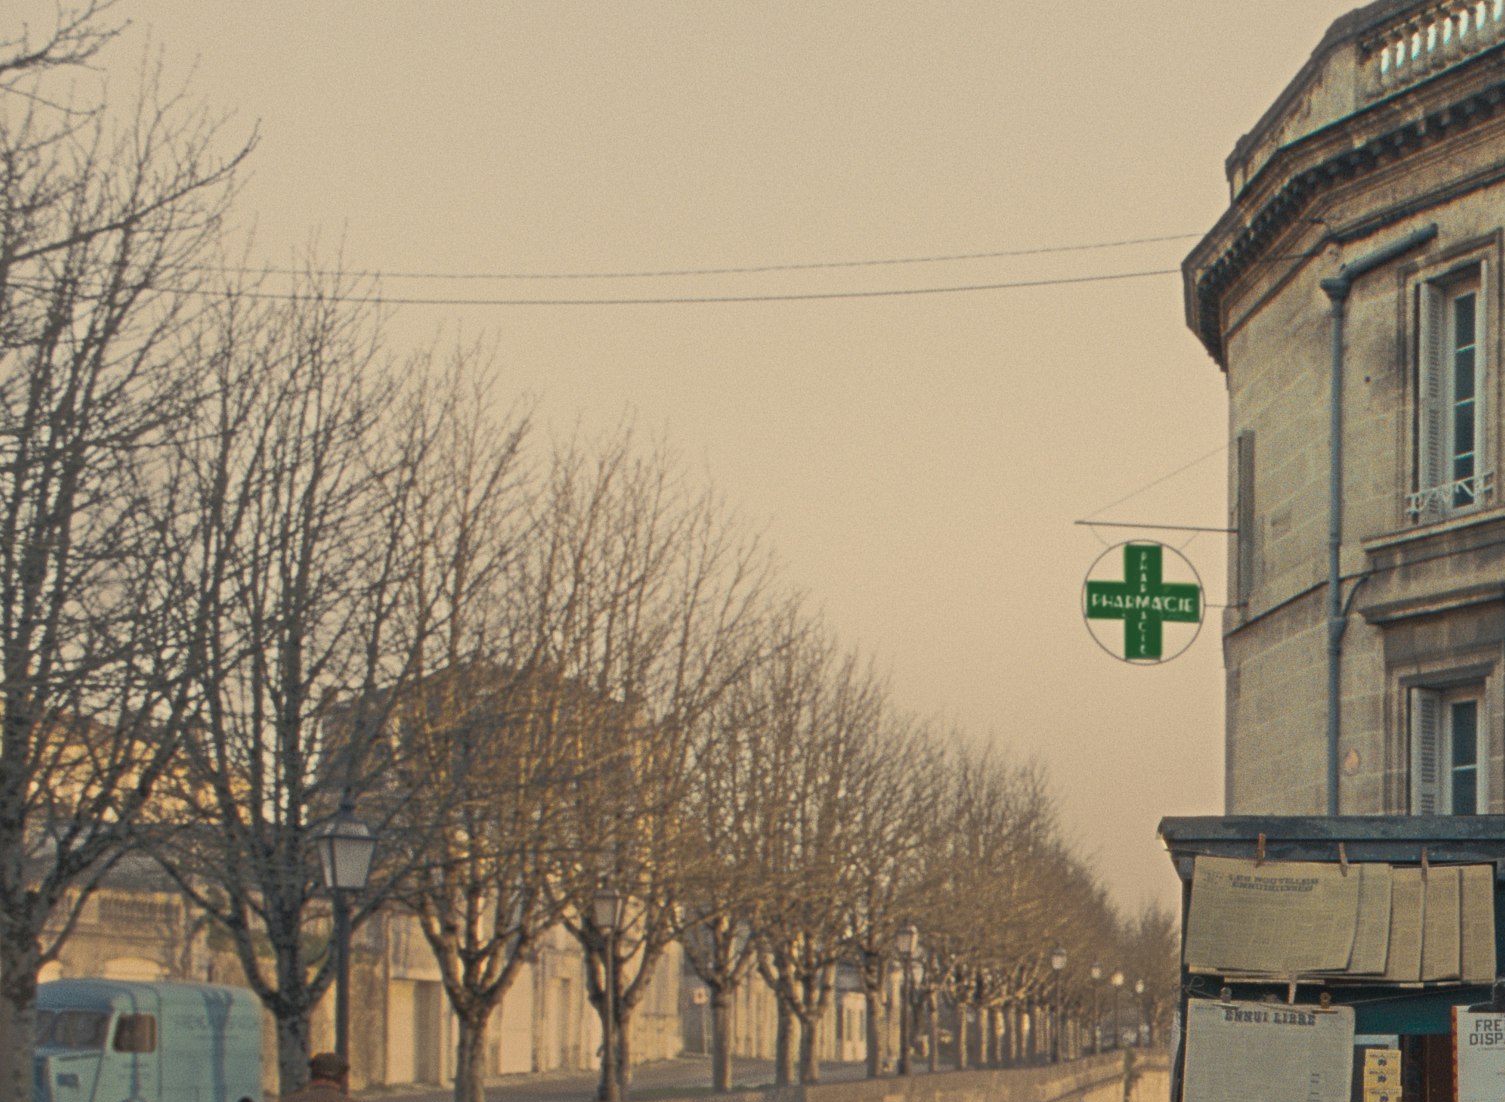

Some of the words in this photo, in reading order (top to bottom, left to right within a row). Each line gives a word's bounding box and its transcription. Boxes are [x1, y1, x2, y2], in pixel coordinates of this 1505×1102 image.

[1092, 593, 1194, 612] PHARMACIE
[1225, 1008, 1269, 1023] ENNUI
[1273, 1012, 1317, 1026] LIBRE
